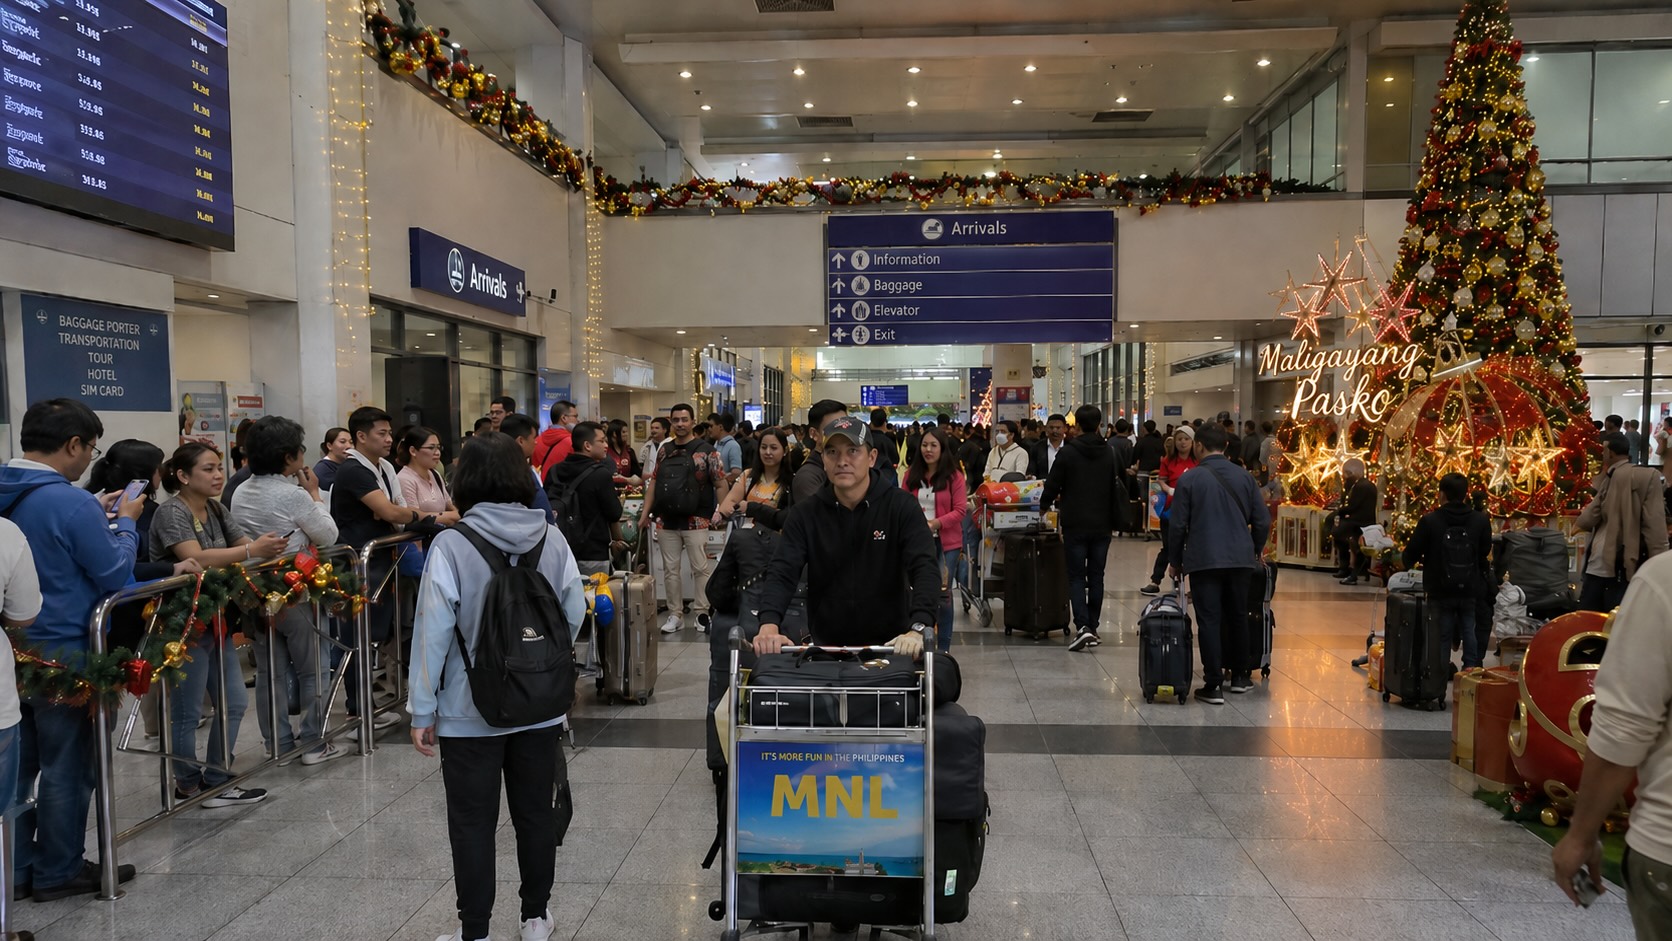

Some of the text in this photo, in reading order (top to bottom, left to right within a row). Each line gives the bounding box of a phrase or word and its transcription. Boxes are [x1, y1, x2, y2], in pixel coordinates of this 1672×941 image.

[951, 220, 1007, 235] Arrivals
[873, 253, 941, 266] Information
[470, 263, 507, 299] Arrivals
[874, 279, 923, 294] Baggage
[874, 304, 920, 316] Elevator
[59, 315, 141, 336] BAGGAGE PORTER
[58, 332, 140, 351] TRANSPORTATION
[874, 328, 896, 341] Exit
[88, 351, 114, 365] TOUR
[1259, 339, 1425, 383] Maligayang
[87, 368, 118, 381] HOTEL
[80, 384, 125, 397] SIM CARD
[1291, 374, 1400, 423] Pasko
[761, 752, 905, 763] IT'S MORE FUN IN THE PHILIPPINES
[771, 774, 898, 819] MNL
